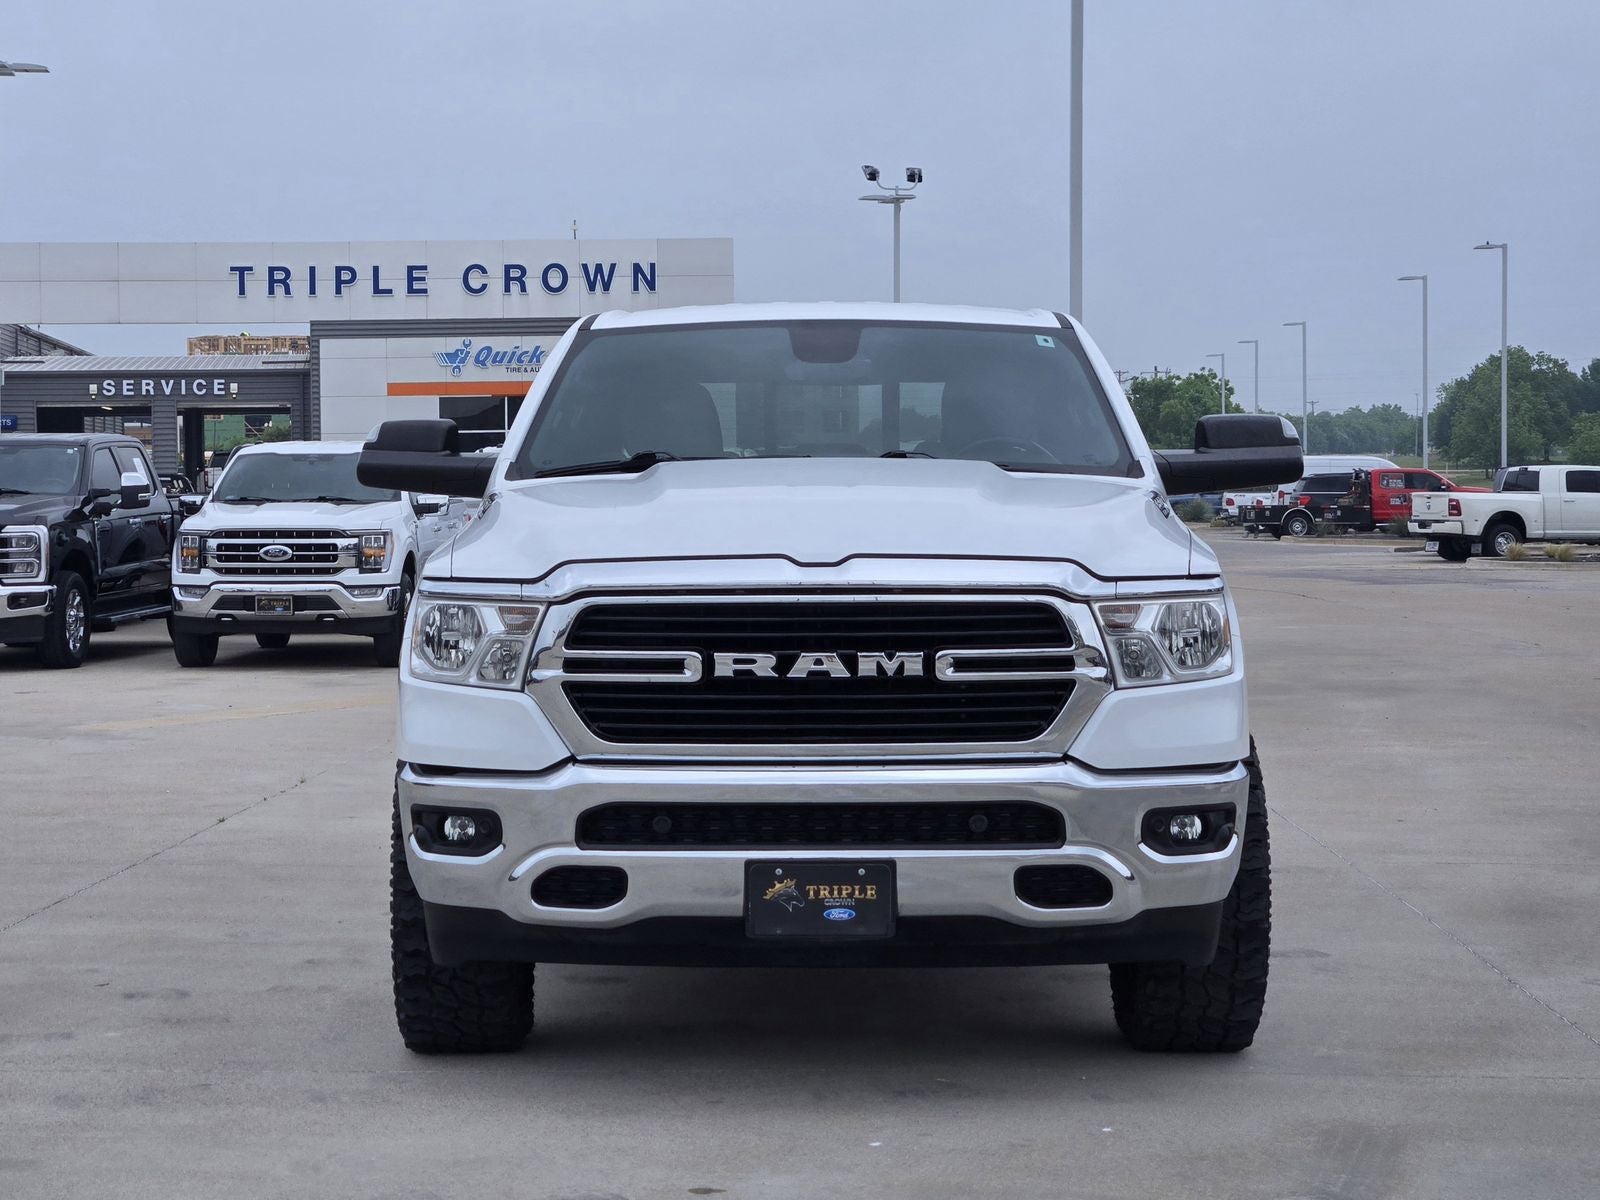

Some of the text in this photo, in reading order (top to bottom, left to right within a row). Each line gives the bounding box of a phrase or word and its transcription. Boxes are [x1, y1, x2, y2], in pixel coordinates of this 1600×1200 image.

[229, 262, 656, 297] TRIPLE CROWN
[474, 345, 546, 369] Quick
[102, 379, 226, 397] SERVICE
[714, 652, 923, 677] RAM
[806, 885, 876, 899] TRIPLE
[824, 898, 855, 906] CROWN
[828, 909, 851, 919] Ford
